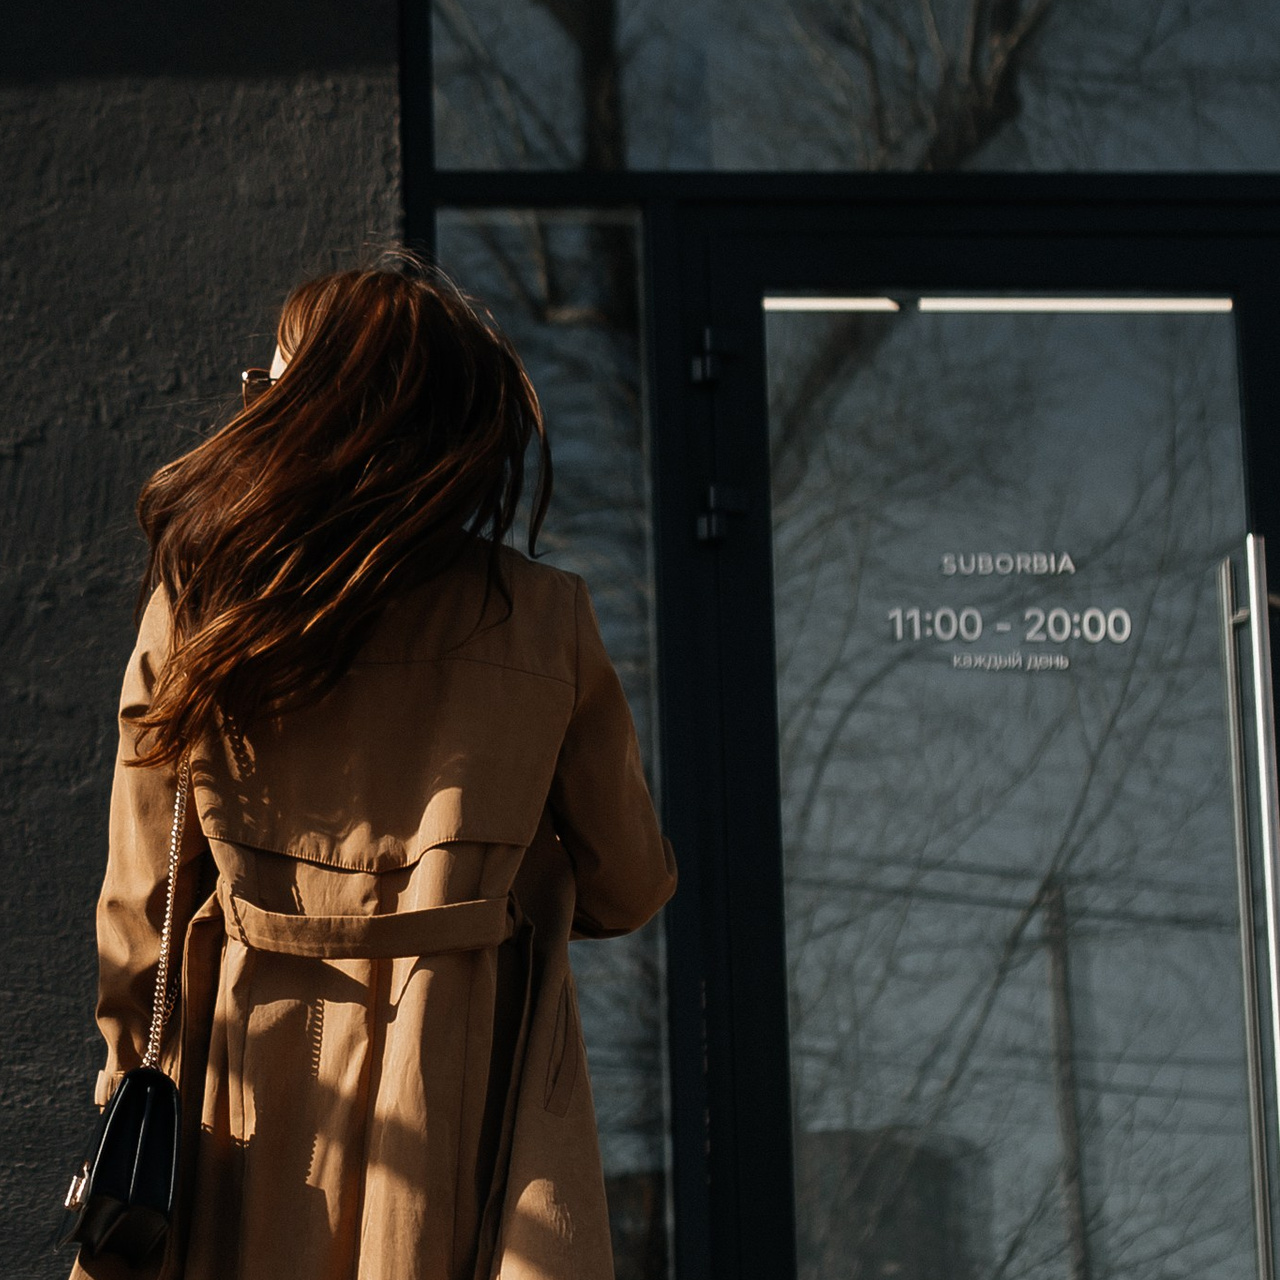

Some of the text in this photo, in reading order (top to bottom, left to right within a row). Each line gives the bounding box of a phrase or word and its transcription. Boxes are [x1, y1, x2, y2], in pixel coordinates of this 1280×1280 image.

[941, 551, 1077, 576] SUBORBIA
[888, 606, 983, 643] 11:00
[1024, 607, 1132, 644] 20:00
[953, 652, 1070, 671] каждый день
